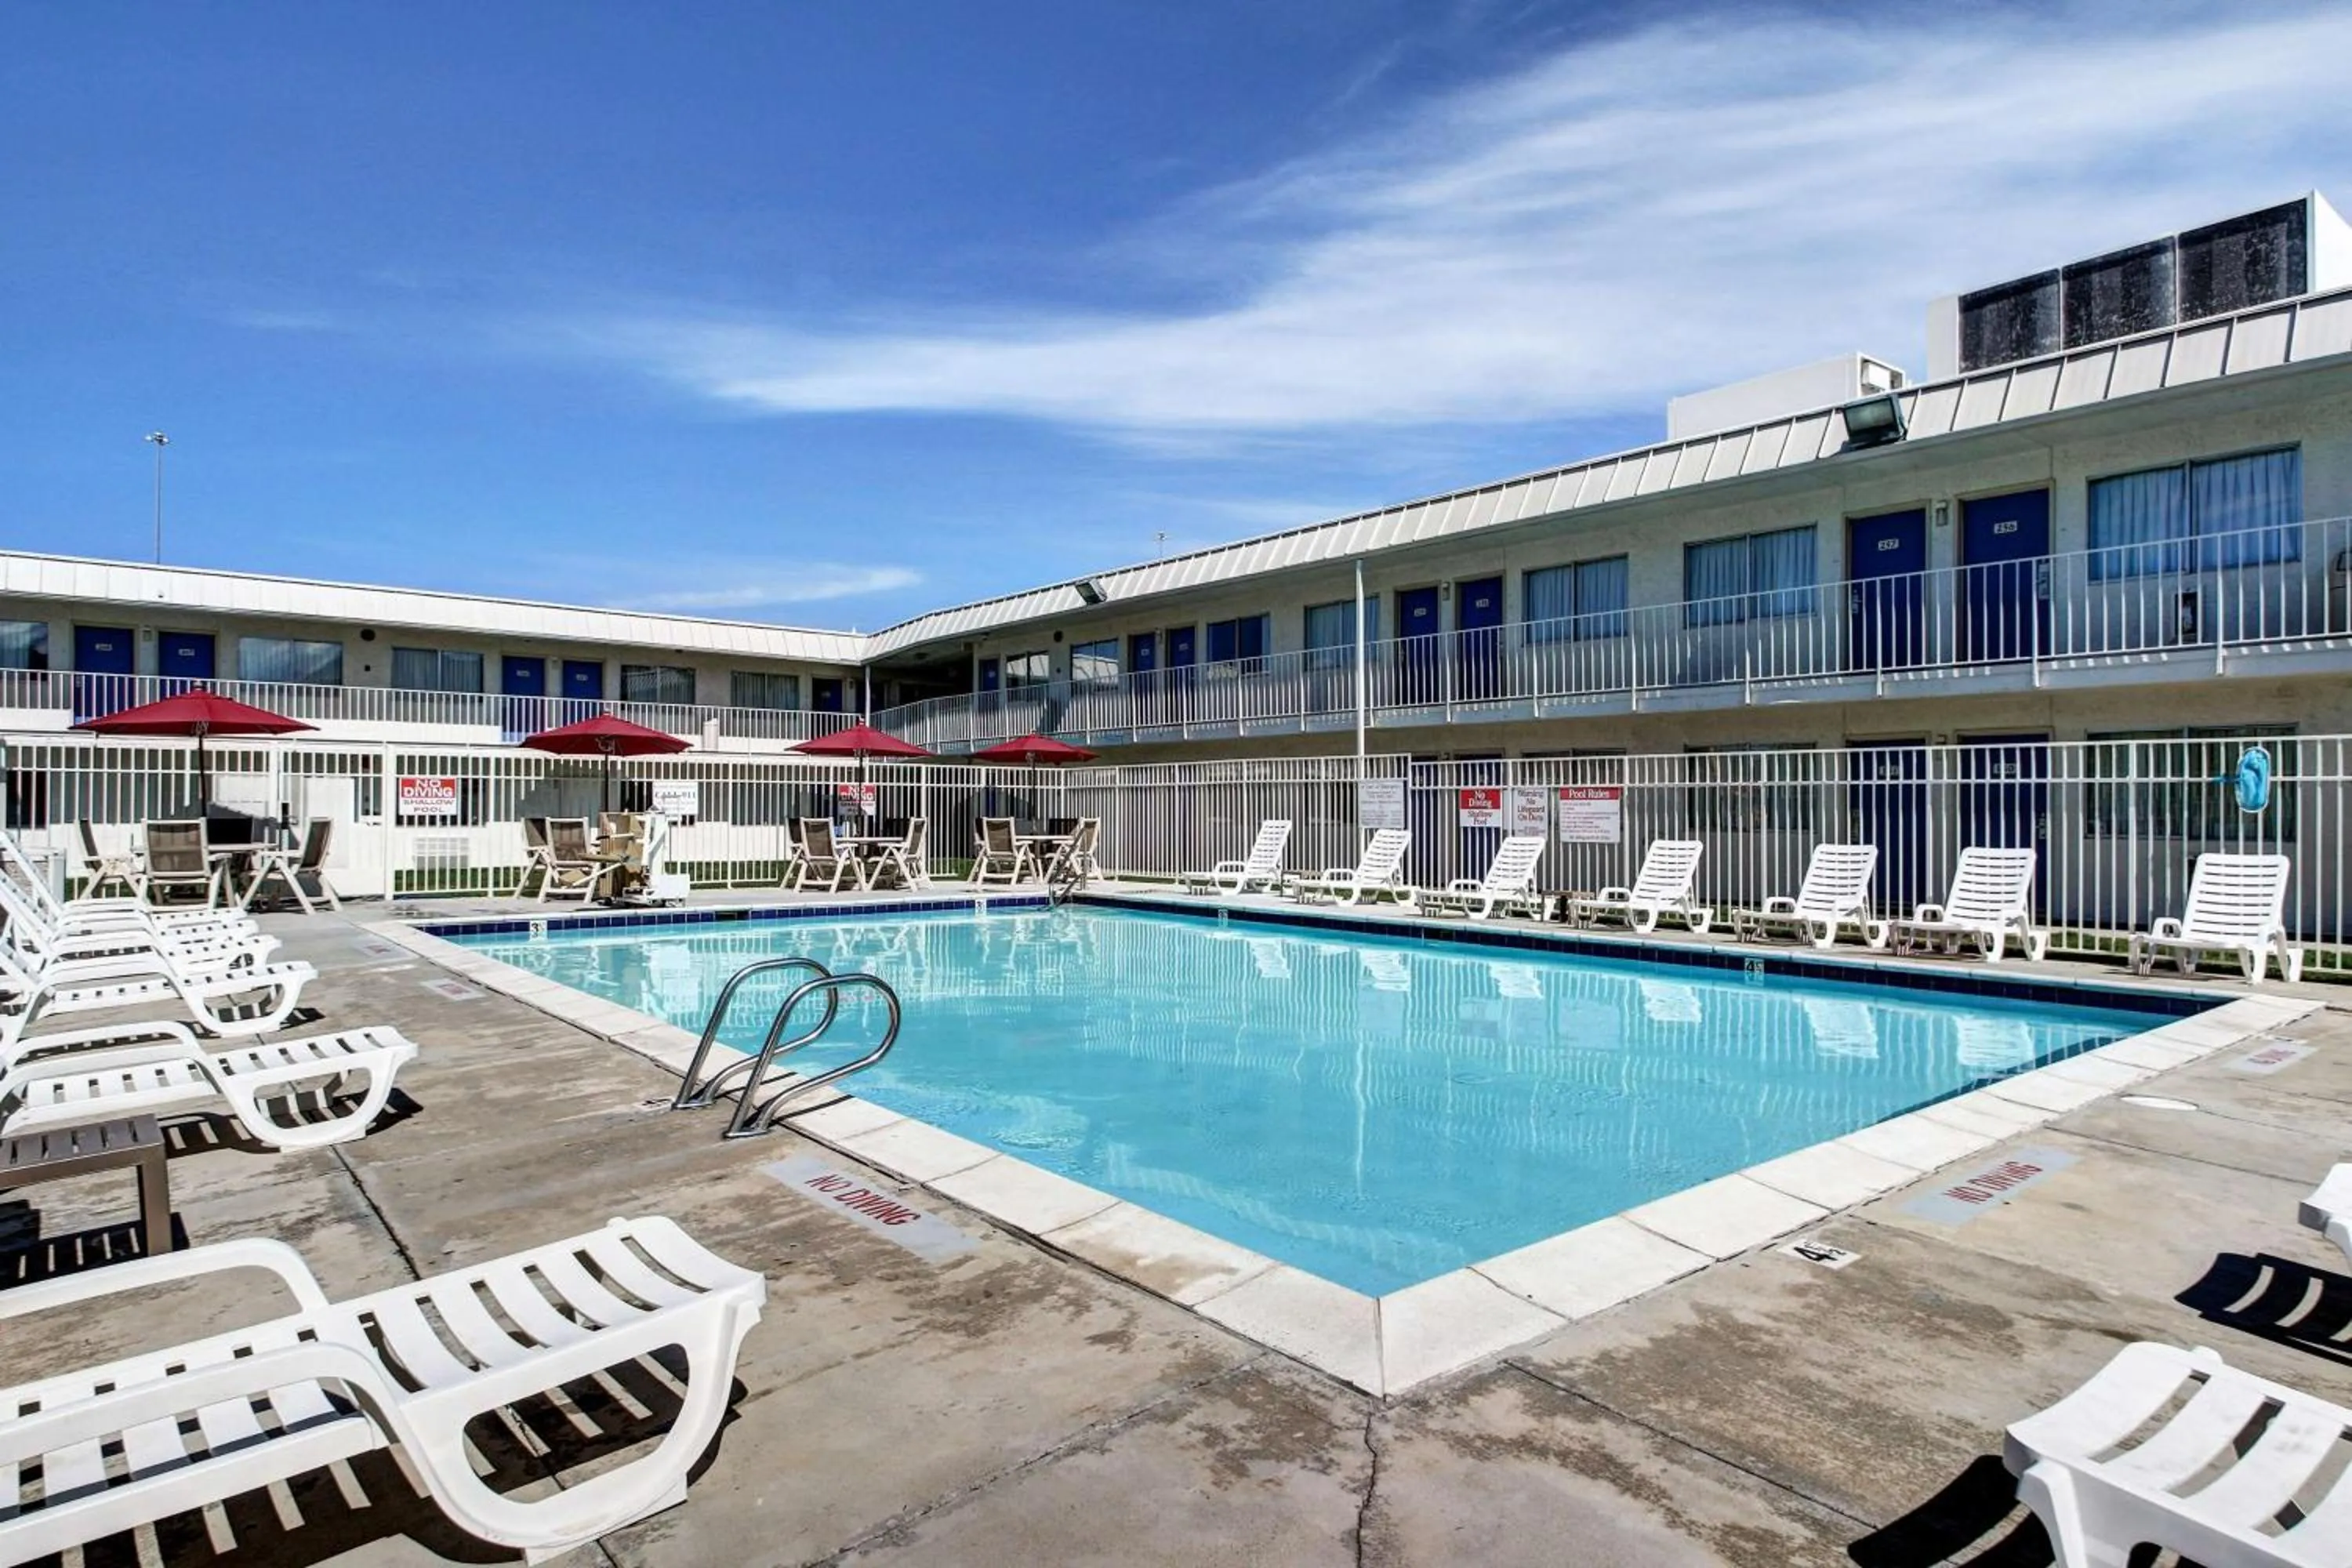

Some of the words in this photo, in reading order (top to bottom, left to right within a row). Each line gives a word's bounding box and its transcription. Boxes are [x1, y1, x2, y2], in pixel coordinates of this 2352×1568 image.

[416, 778, 441, 787] NO
[404, 787, 452, 797] DIVING
[1475, 789, 1486, 800] No
[1570, 789, 1585, 798] Pool
[1588, 789, 1610, 799] Rules
[1468, 798, 1493, 808] Diving
[1518, 805, 1544, 815] Lifeguard
[1966, 1160, 2043, 1191] DIVING
[804, 1174, 854, 1192] NO
[833, 1188, 921, 1225] DIVING
[1943, 1186, 1994, 1205] NO
